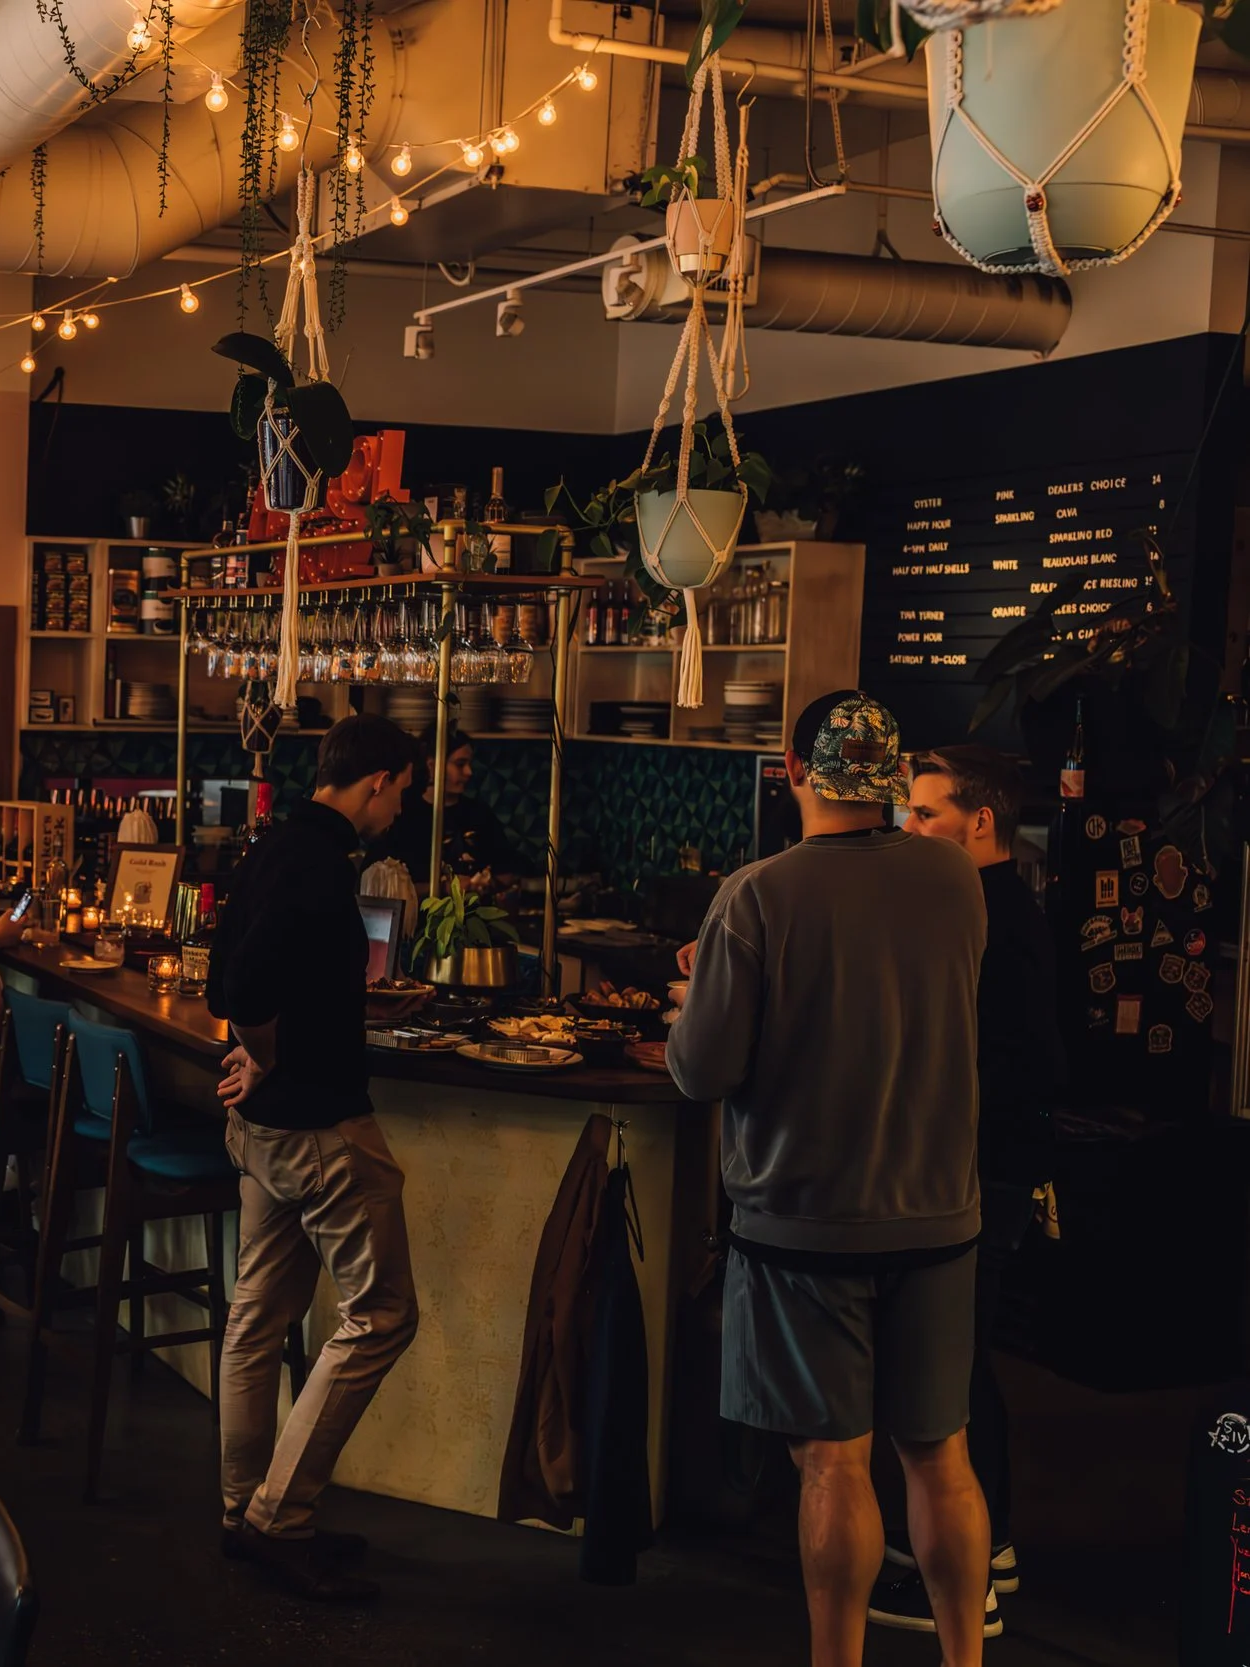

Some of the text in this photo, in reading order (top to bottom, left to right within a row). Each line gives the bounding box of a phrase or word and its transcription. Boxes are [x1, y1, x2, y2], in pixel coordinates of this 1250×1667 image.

[1047, 482, 1084, 496] DEALERS
[1090, 477, 1127, 491] CHOICE
[995, 490, 1015, 501] PINK
[914, 498, 943, 509] OYSTER
[995, 511, 1036, 525] SPARKLING
[1055, 507, 1078, 519] CAVA
[907, 519, 952, 531] HAPPY HOUR
[1049, 528, 1114, 544] SPARKLING RED
[928, 542, 949, 552] DAILY
[992, 560, 1019, 570] WHITE
[1090, 553, 1118, 566] BLANC
[892, 563, 970, 576] HALF OFF HALF SHELLS
[1099, 578, 1138, 590] RIESLING
[918, 610, 946, 621] TURNER
[991, 605, 1027, 618] ORANGE
[897, 632, 944, 643] POWER HOUR
[889, 654, 924, 665] SATURDAY
